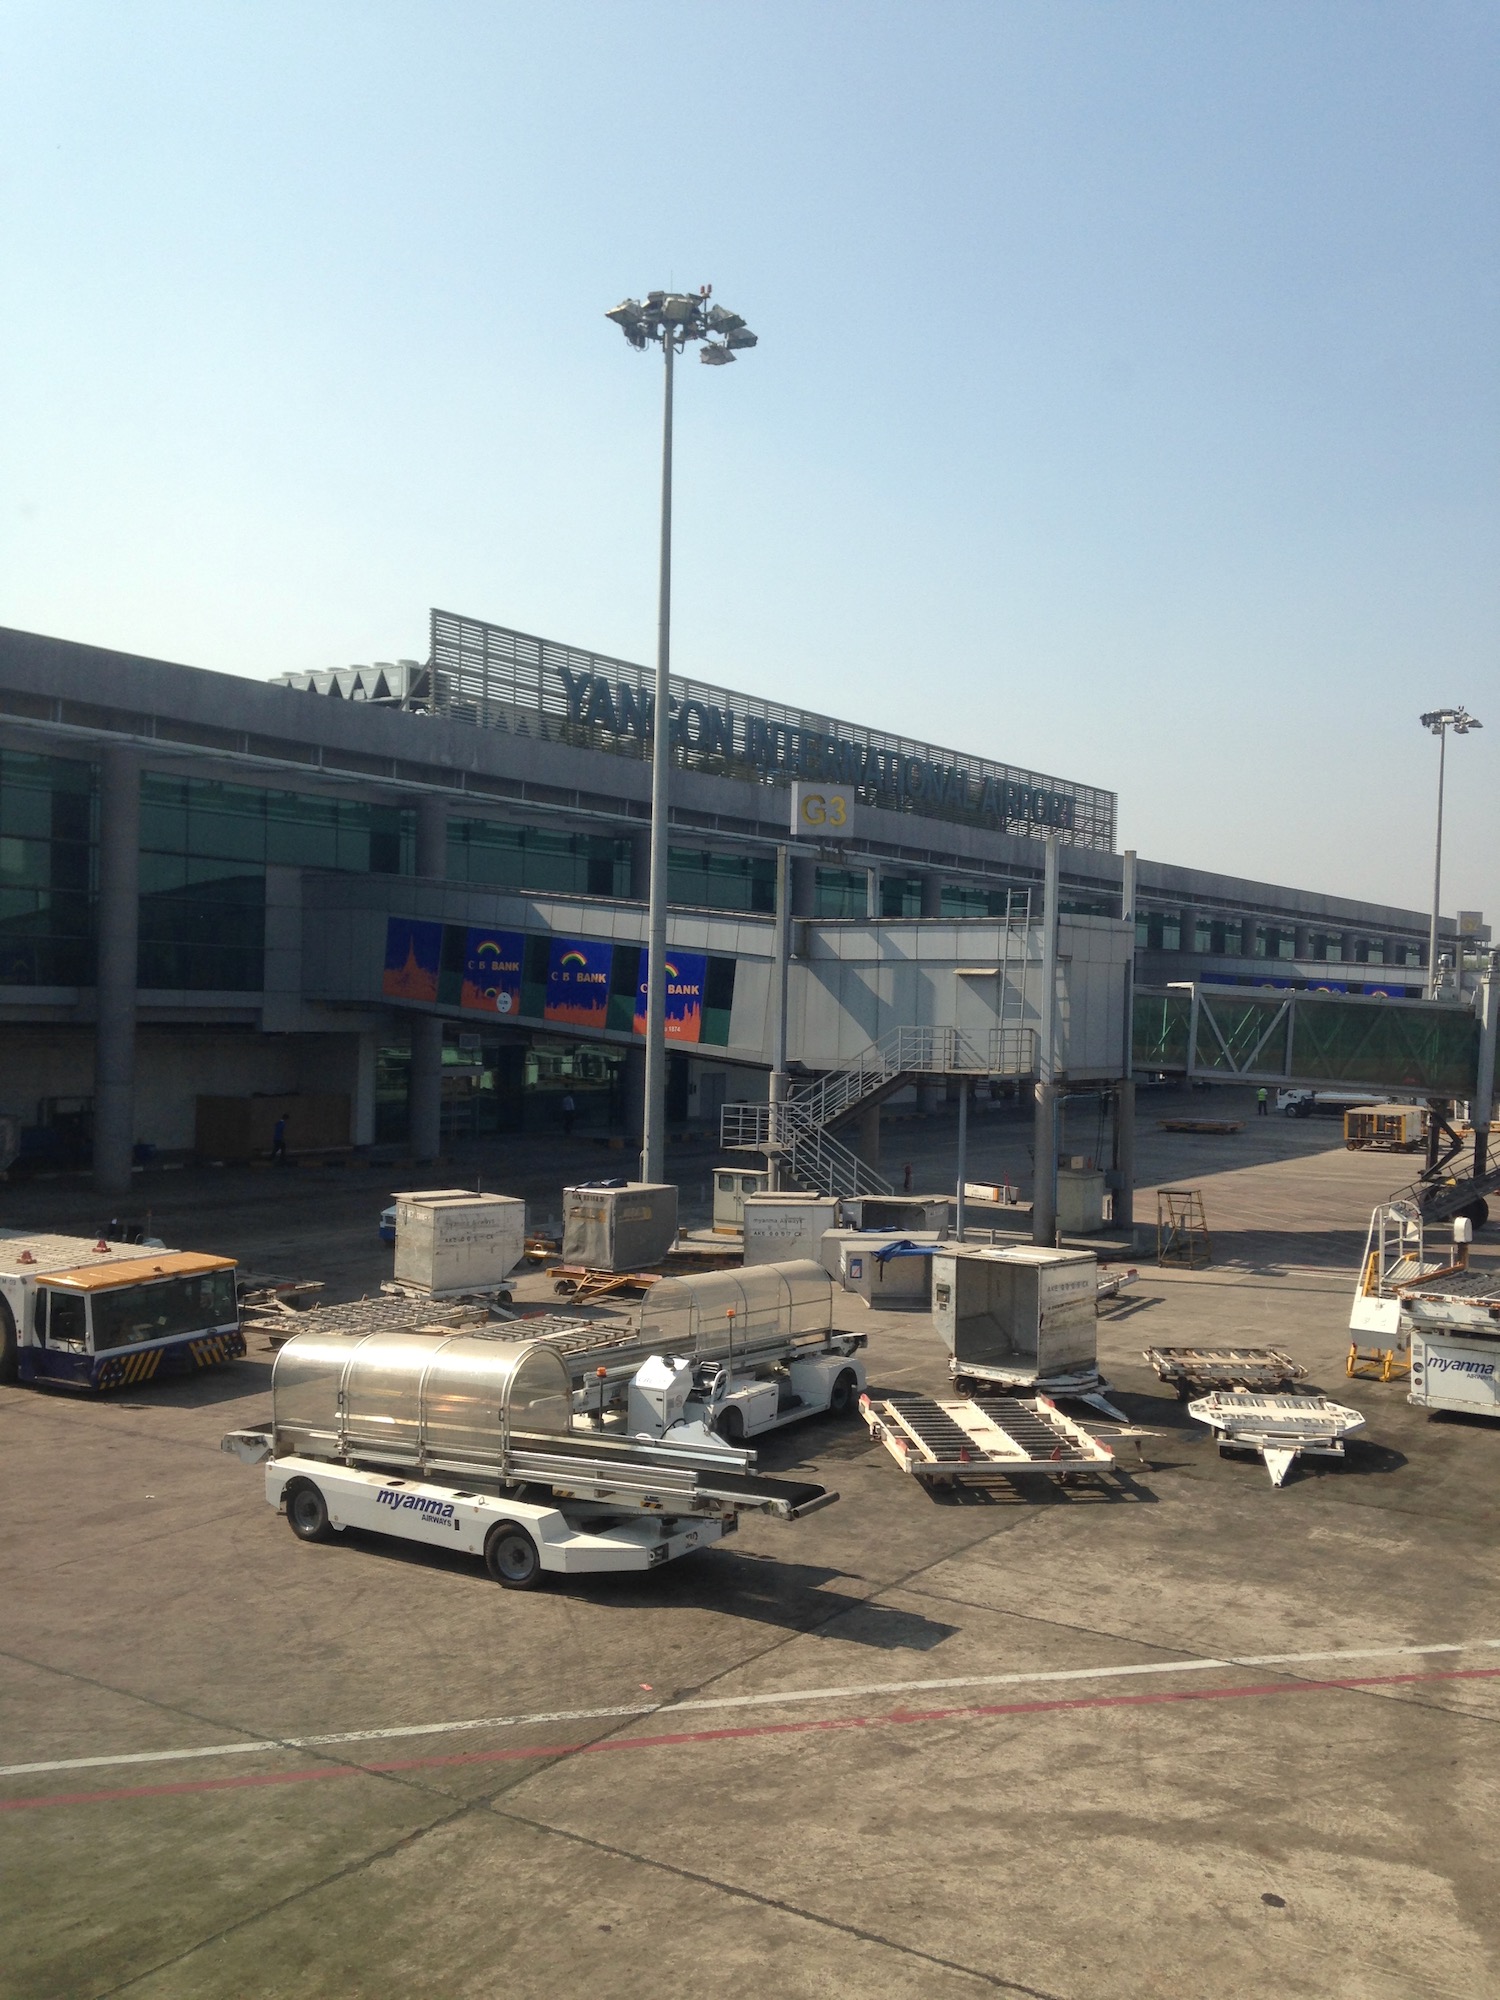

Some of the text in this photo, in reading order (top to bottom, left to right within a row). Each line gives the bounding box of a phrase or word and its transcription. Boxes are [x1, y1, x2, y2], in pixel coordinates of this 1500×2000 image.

[744, 714, 974, 808] INTERNATIONAL
[979, 774, 1077, 830] AIRPORT
[800, 791, 847, 827] G3
[491, 961, 520, 972] BANK
[576, 972, 607, 984] BANK
[667, 984, 700, 996] BANK
[1426, 1355, 1496, 1375] myanma
[375, 1489, 455, 1519] myanma
[421, 1513, 453, 1528] AIRWAYS
